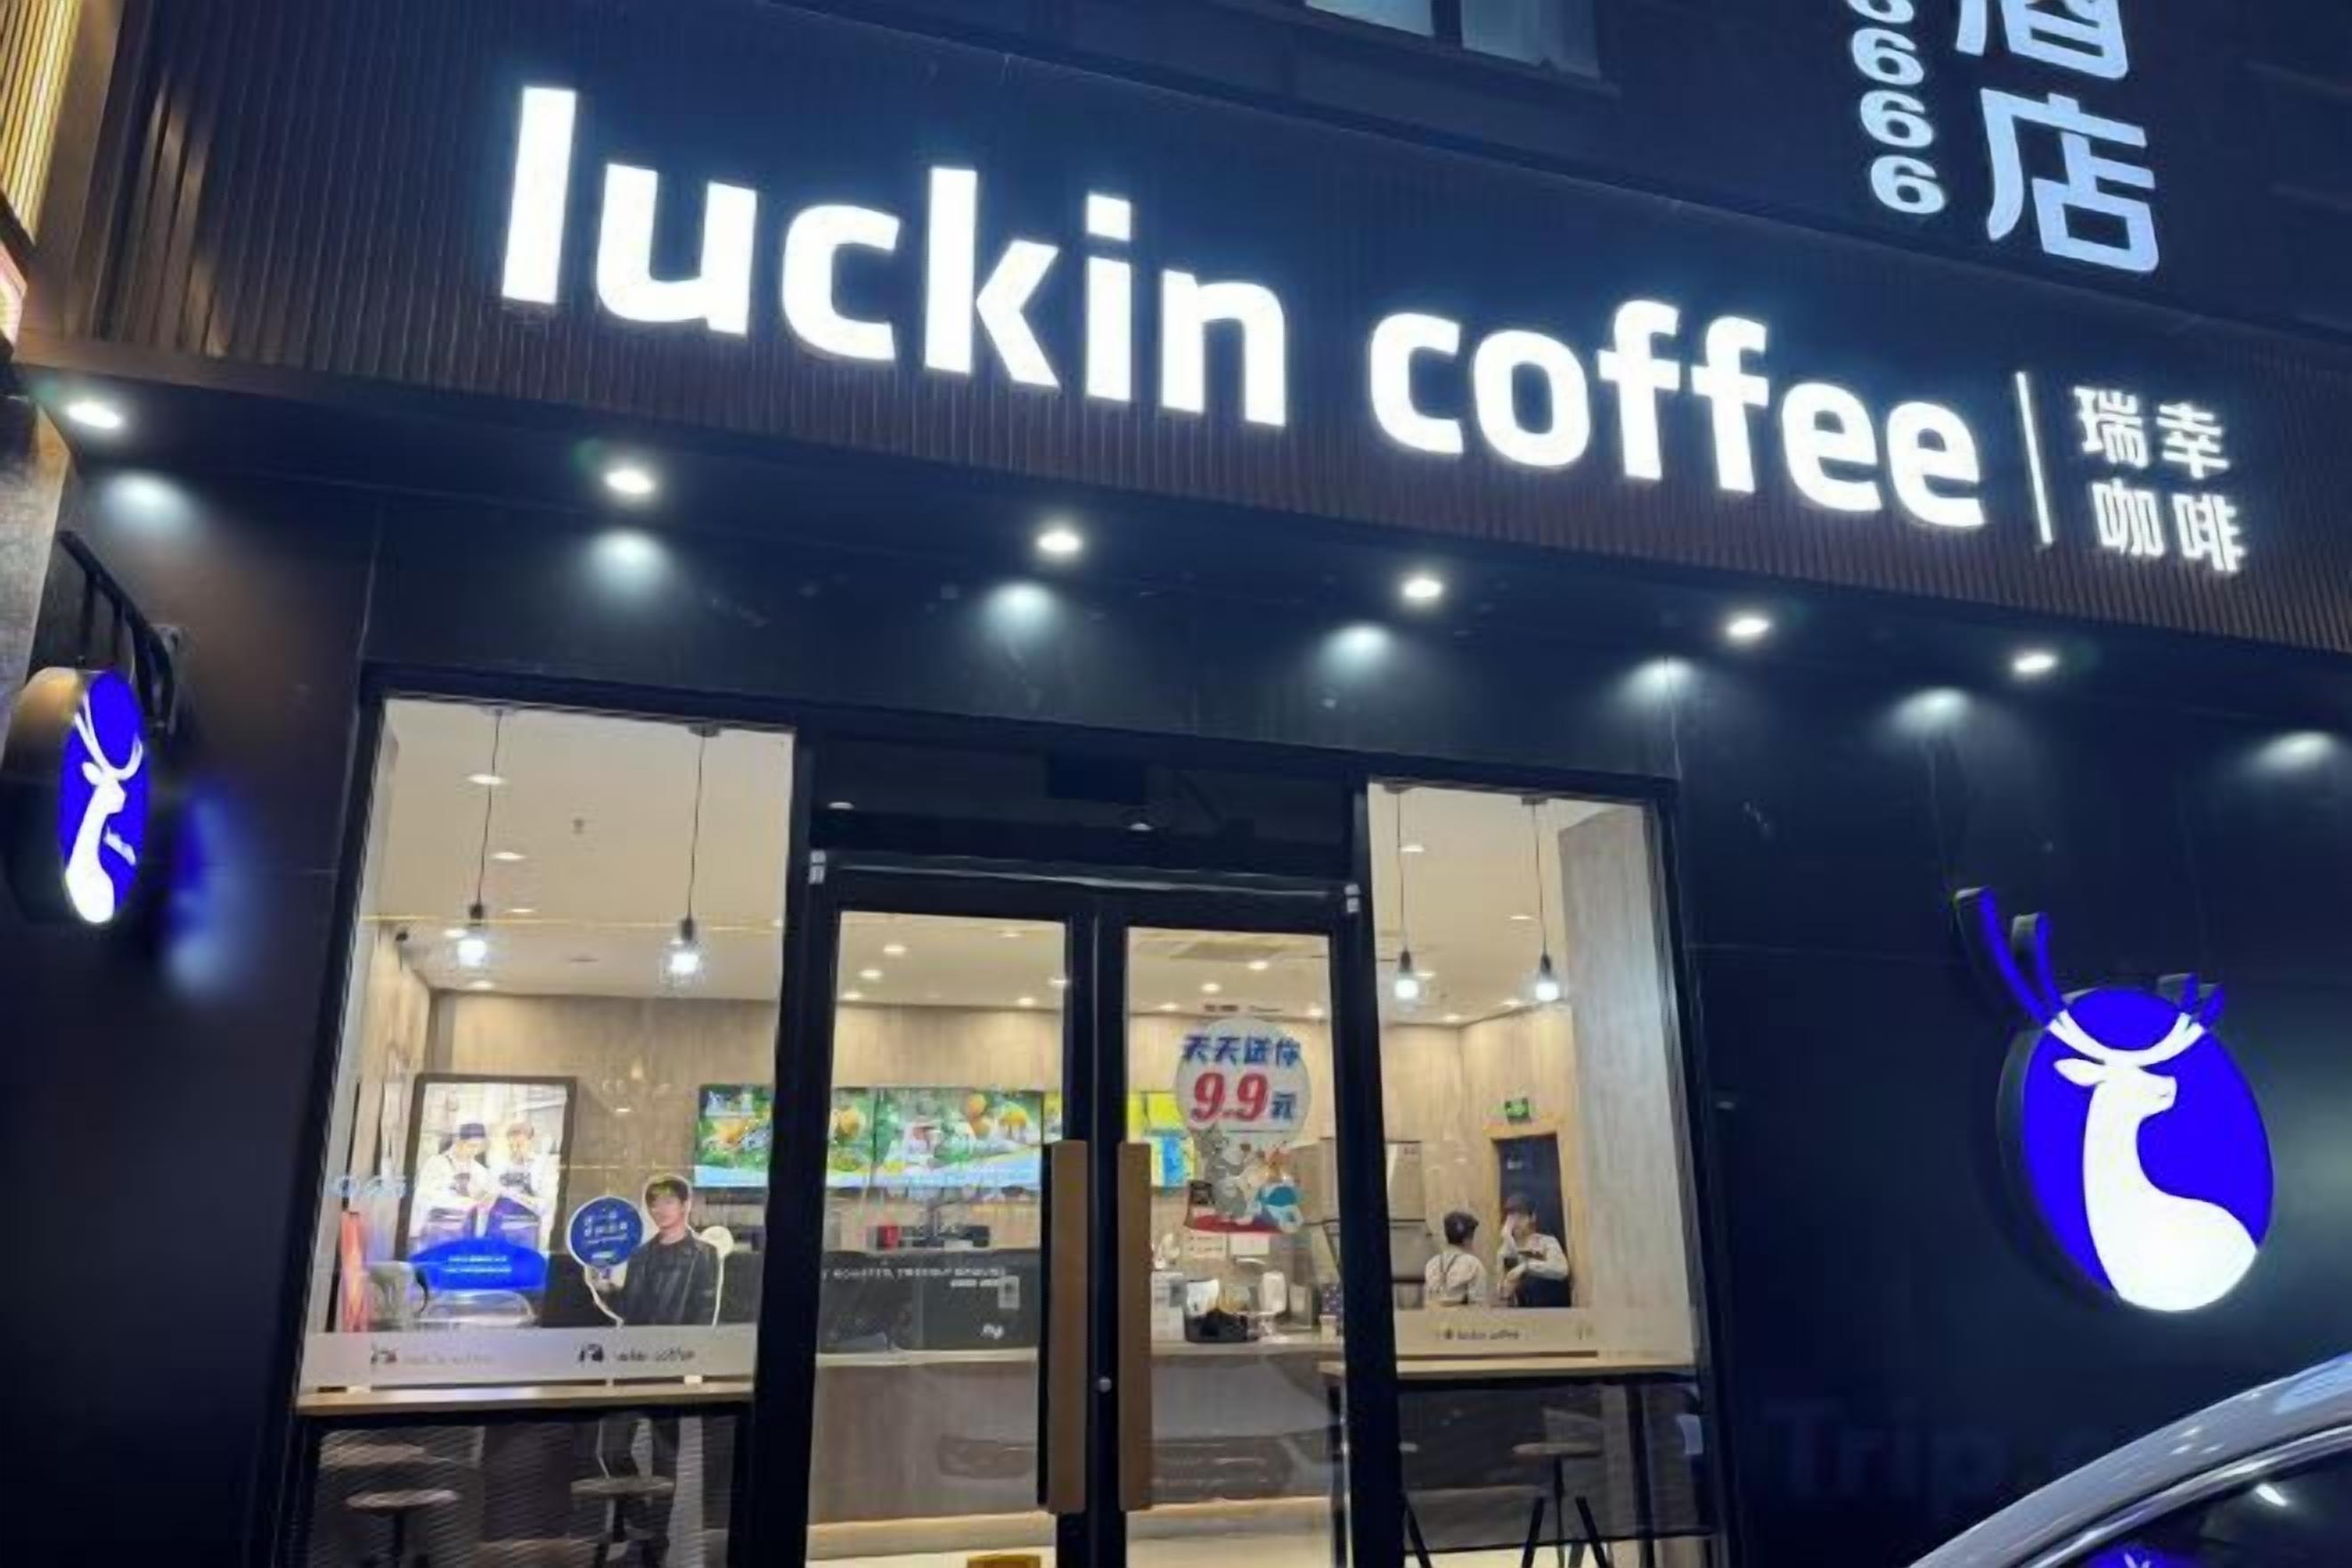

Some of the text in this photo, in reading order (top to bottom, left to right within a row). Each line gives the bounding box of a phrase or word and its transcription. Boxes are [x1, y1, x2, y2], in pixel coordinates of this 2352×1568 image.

[501, 86, 1986, 528] luckin coffee
[2073, 386, 2230, 479] 瑞幸
[2091, 478, 2246, 573] 咖啡
